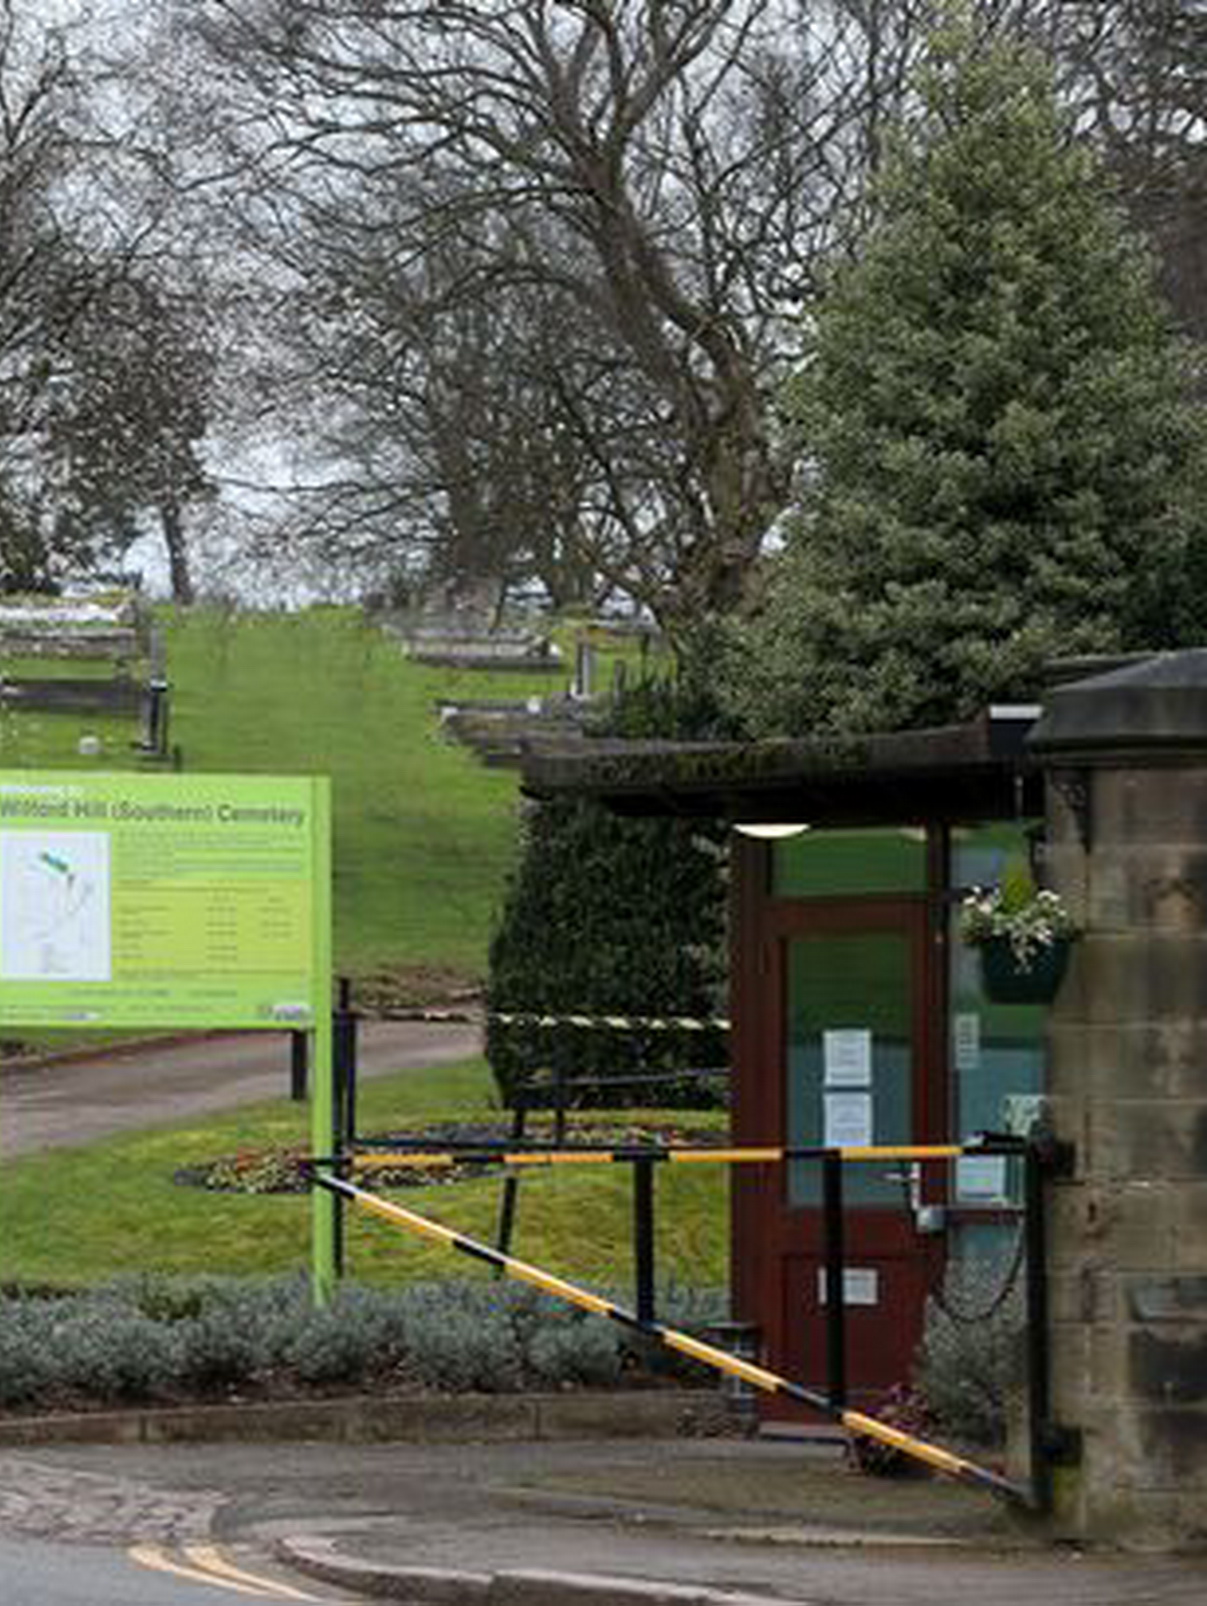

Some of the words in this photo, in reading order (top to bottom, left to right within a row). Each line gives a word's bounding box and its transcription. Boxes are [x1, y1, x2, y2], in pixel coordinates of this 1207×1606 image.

[74, 799, 107, 819] Hill
[110, 800, 213, 823] (Southern)
[217, 804, 306, 827] Cemetery
